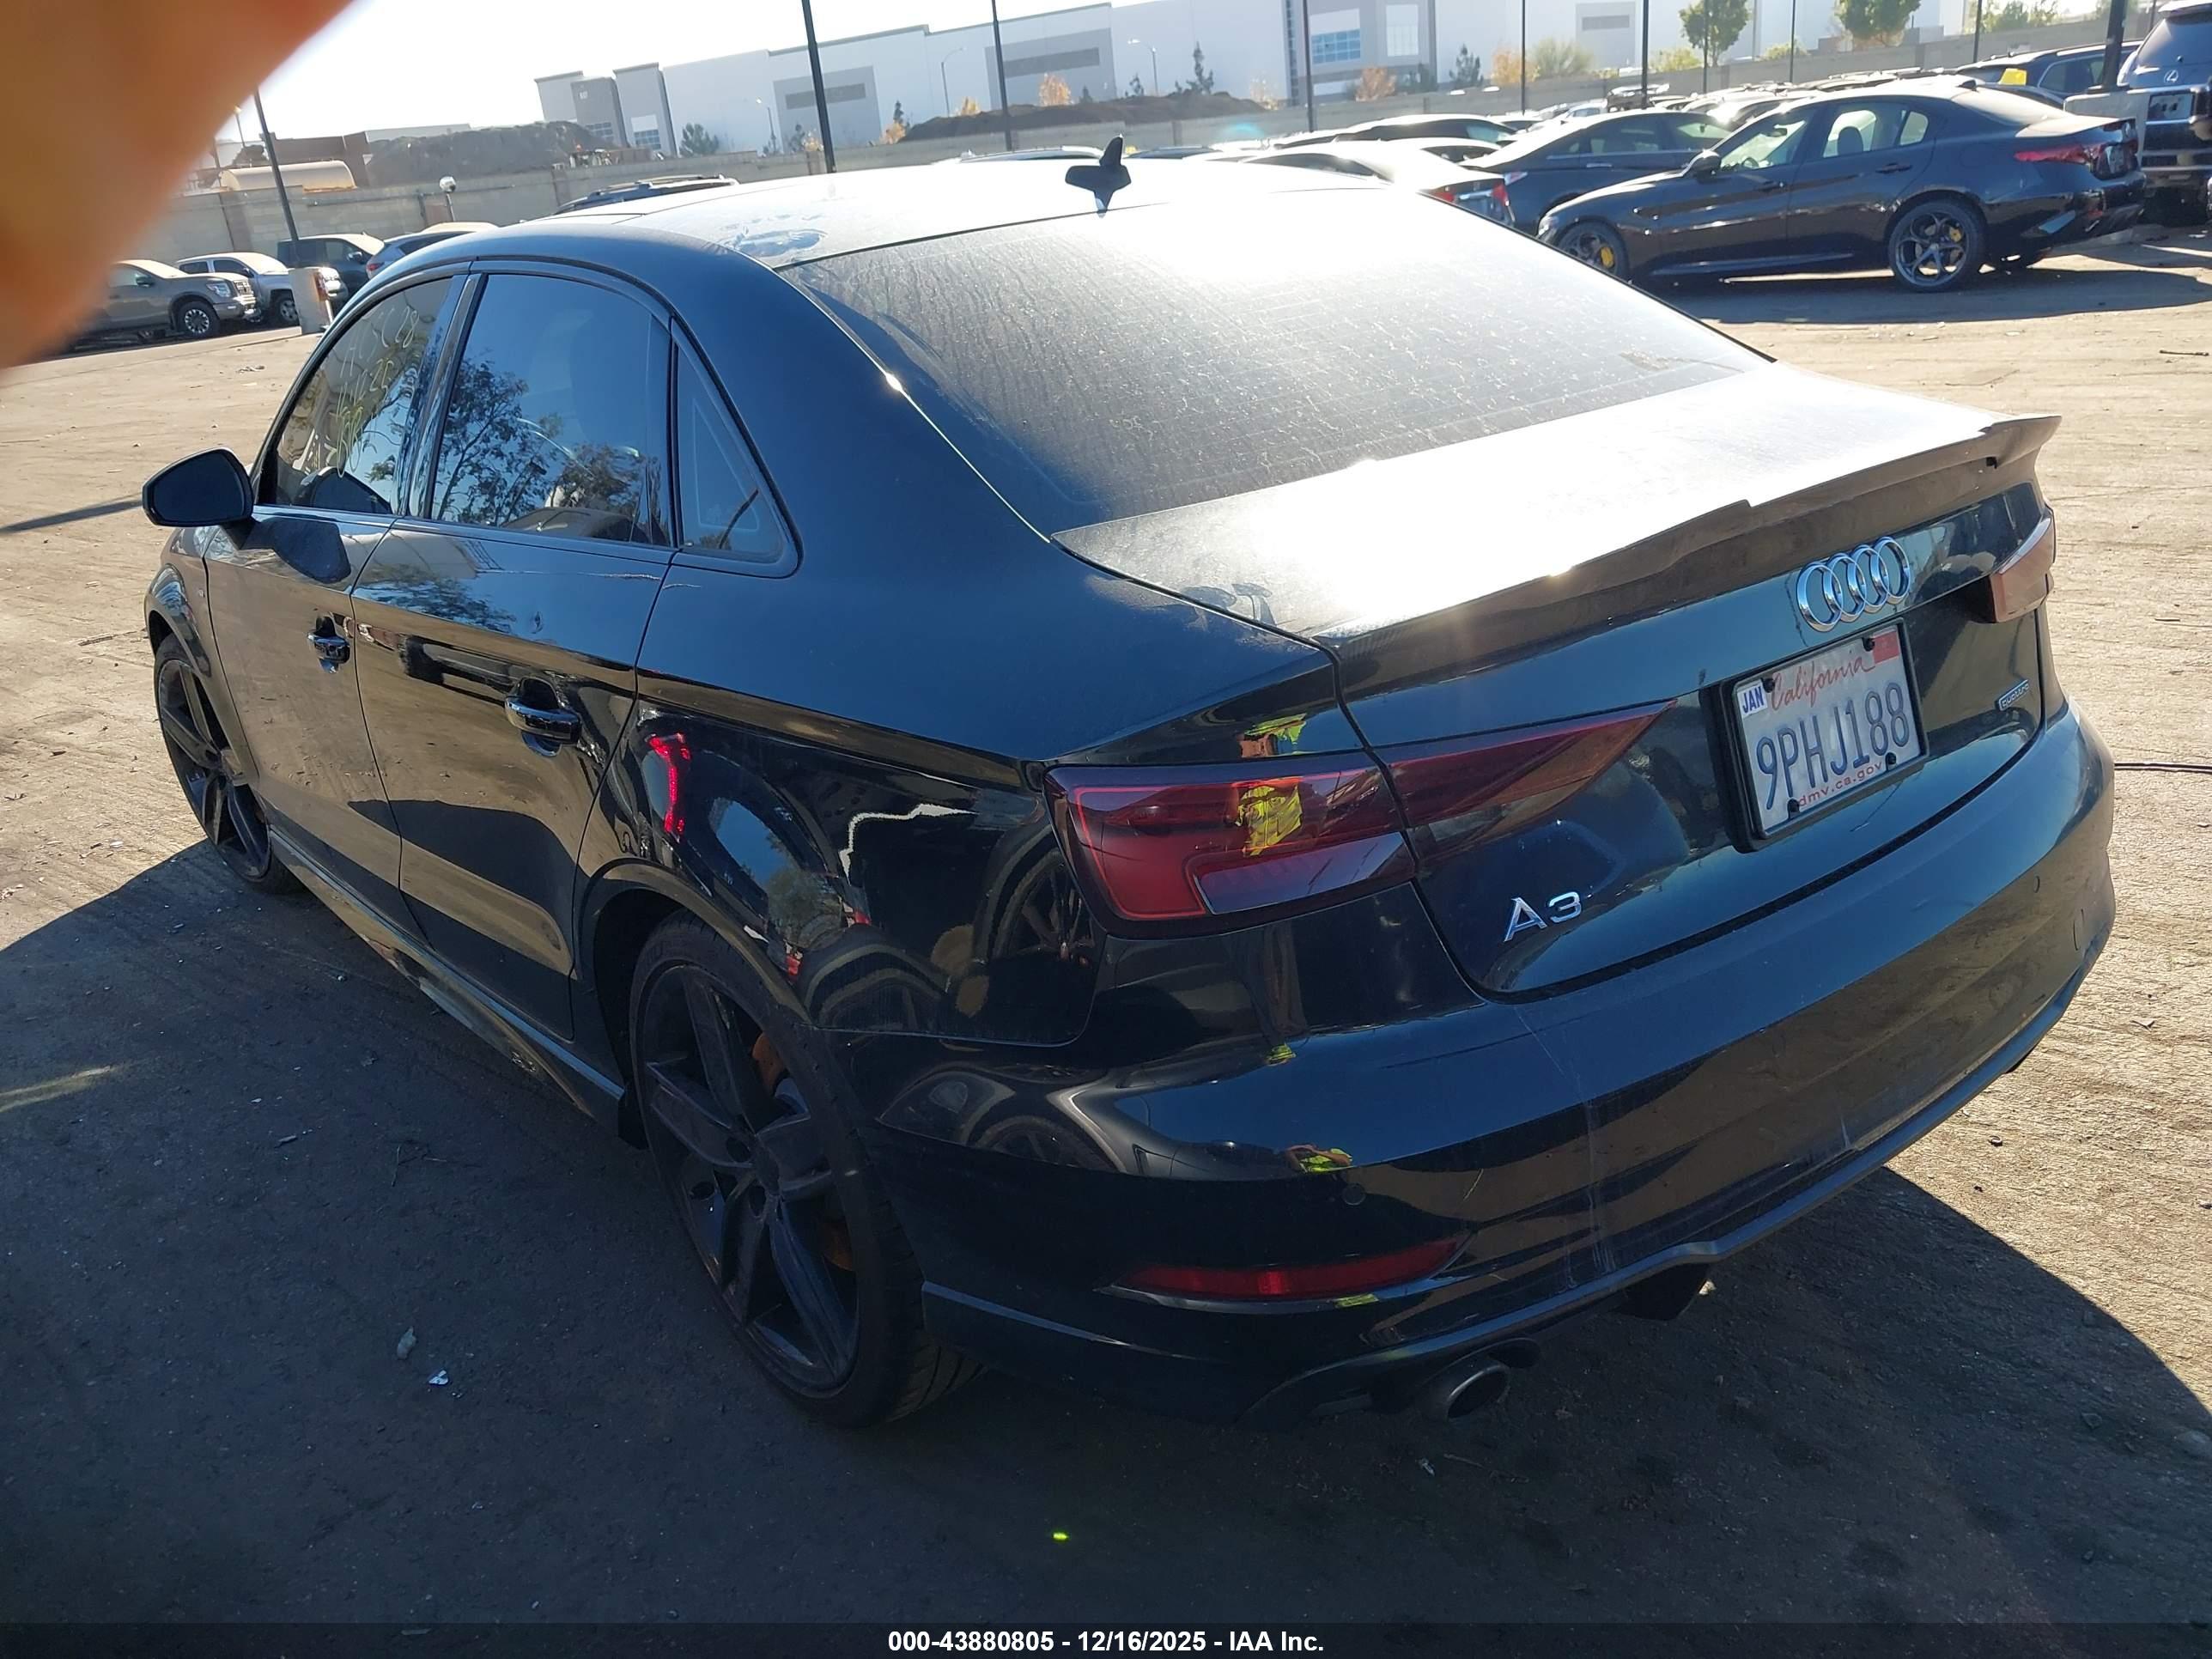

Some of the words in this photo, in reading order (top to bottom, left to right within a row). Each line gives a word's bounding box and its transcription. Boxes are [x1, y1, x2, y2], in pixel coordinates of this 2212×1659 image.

[1741, 684, 1765, 714] JAN
[1771, 649, 1876, 712] California
[1755, 681, 1911, 811] 9PHJ188
[1796, 760, 1883, 809] dmv.ca.gov
[1503, 891, 1583, 942] A3
